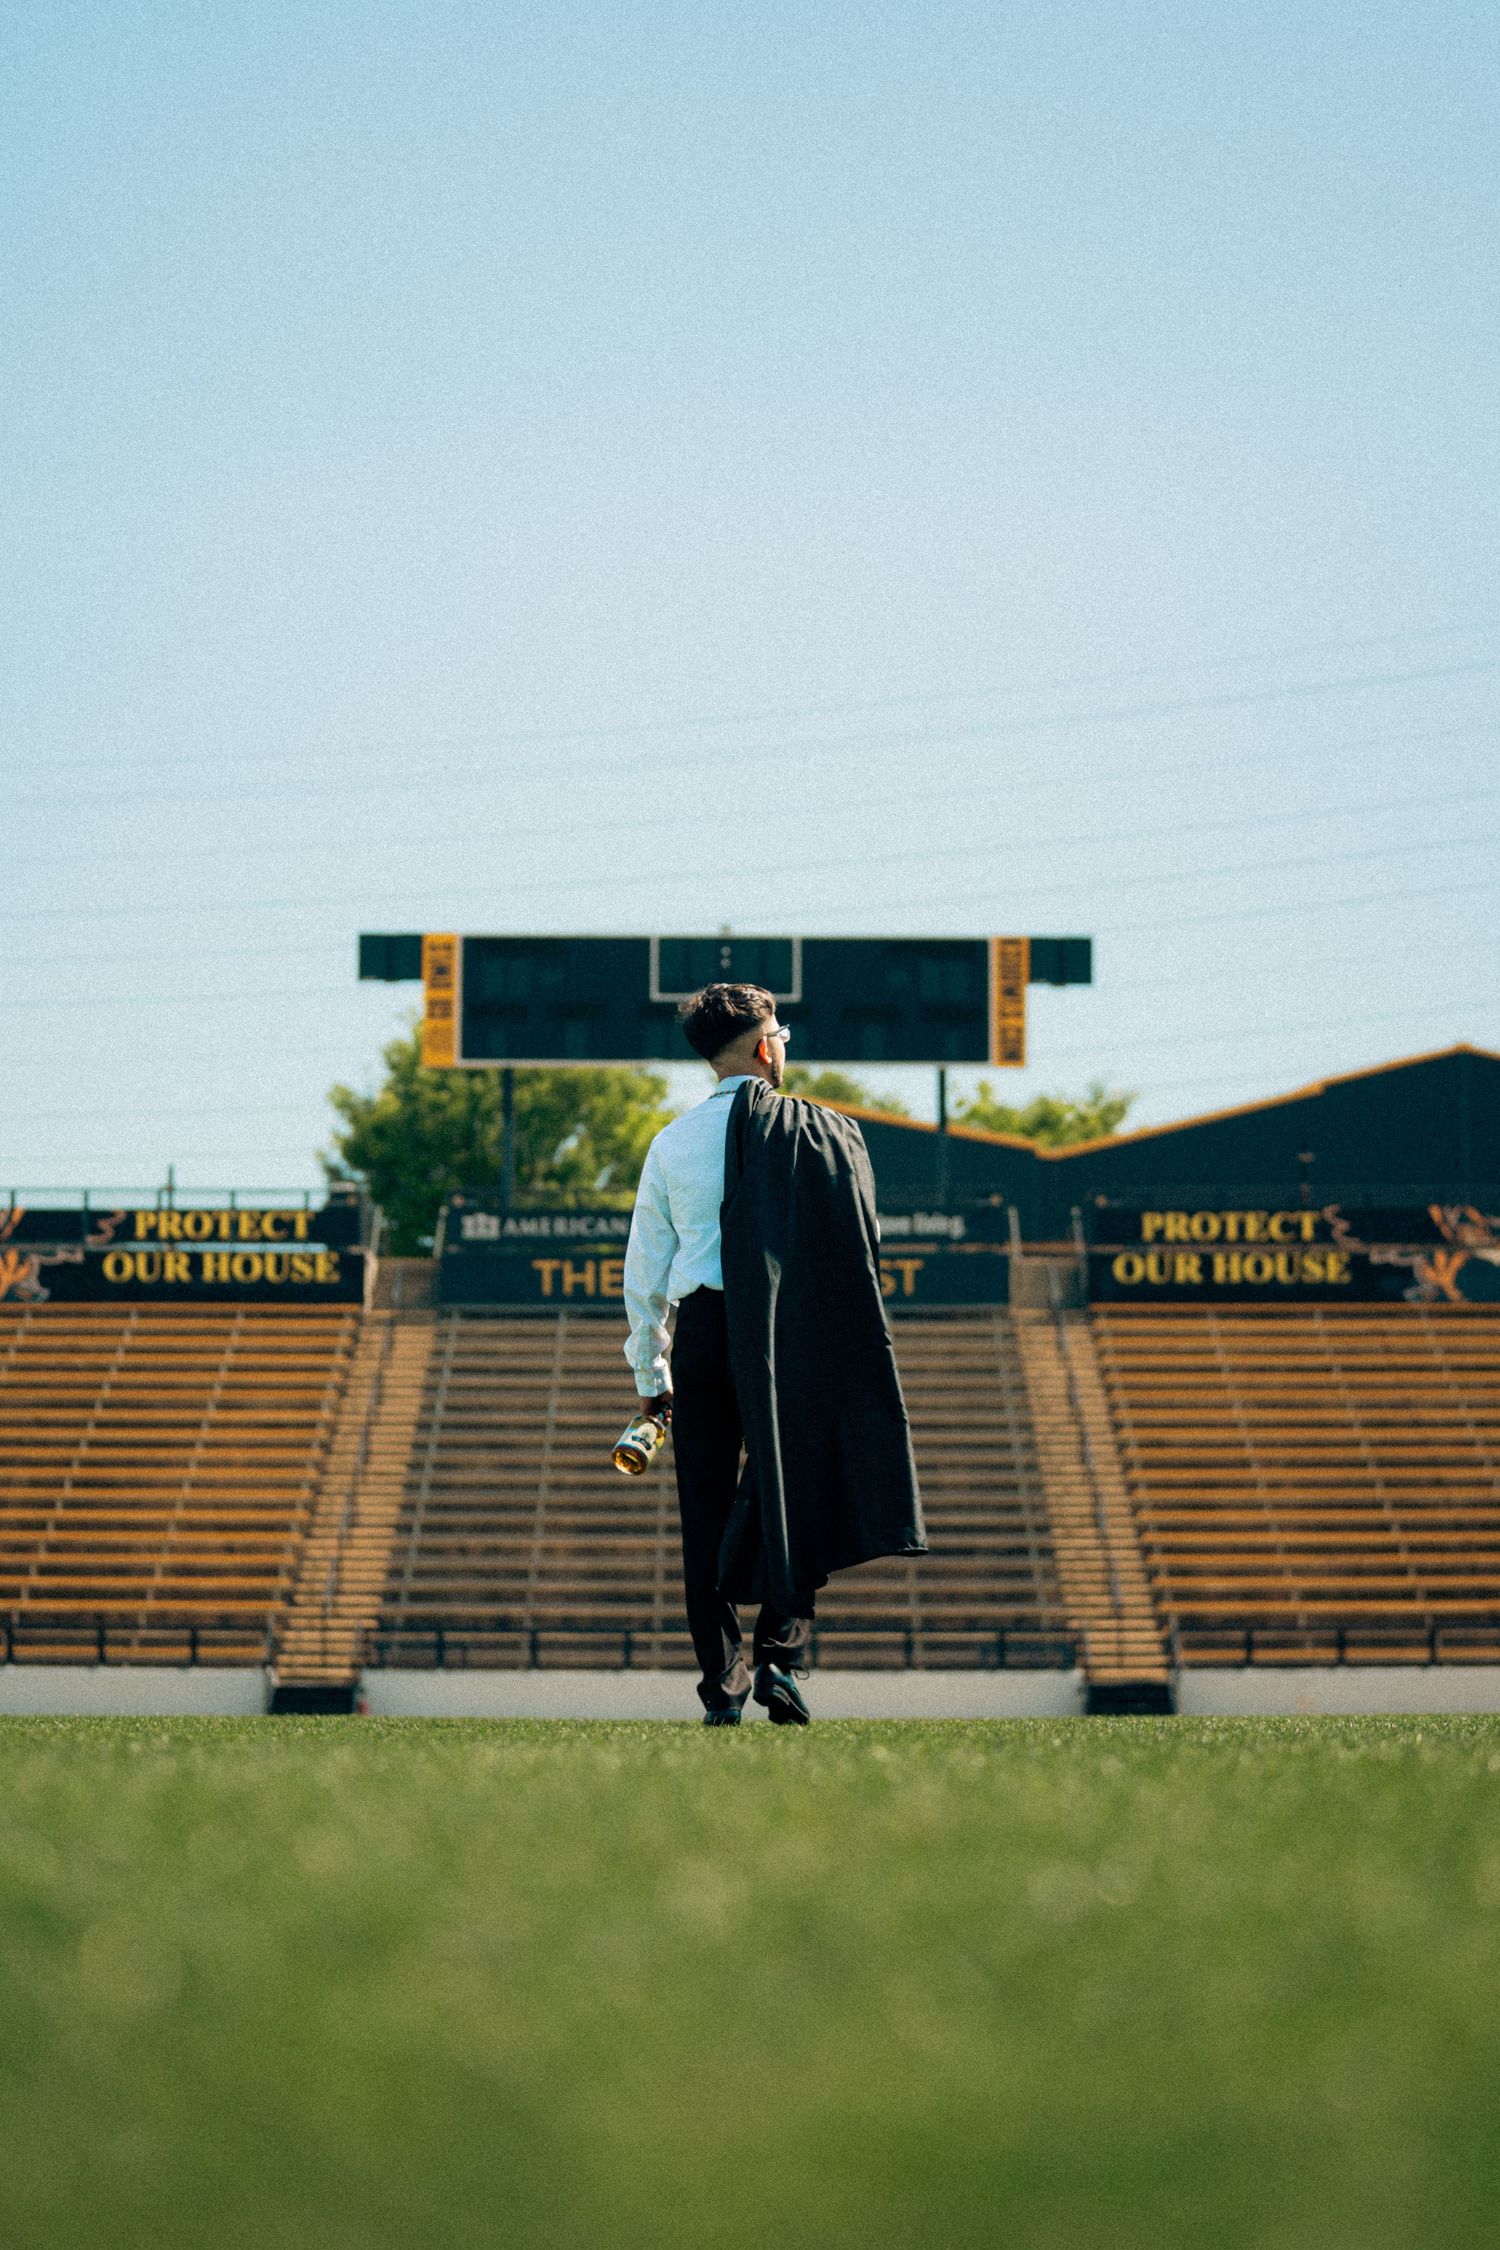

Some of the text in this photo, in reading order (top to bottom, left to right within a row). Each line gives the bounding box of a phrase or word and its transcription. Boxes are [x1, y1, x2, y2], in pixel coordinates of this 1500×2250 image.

[134, 1210, 314, 1240] PROTECT
[503, 1216, 629, 1237] AMERICAN
[1141, 1210, 1319, 1242] PROTECT
[102, 1251, 341, 1284] OUR HOUSE
[531, 1258, 624, 1296] THE
[1112, 1251, 1351, 1285] OUR HOUSE
